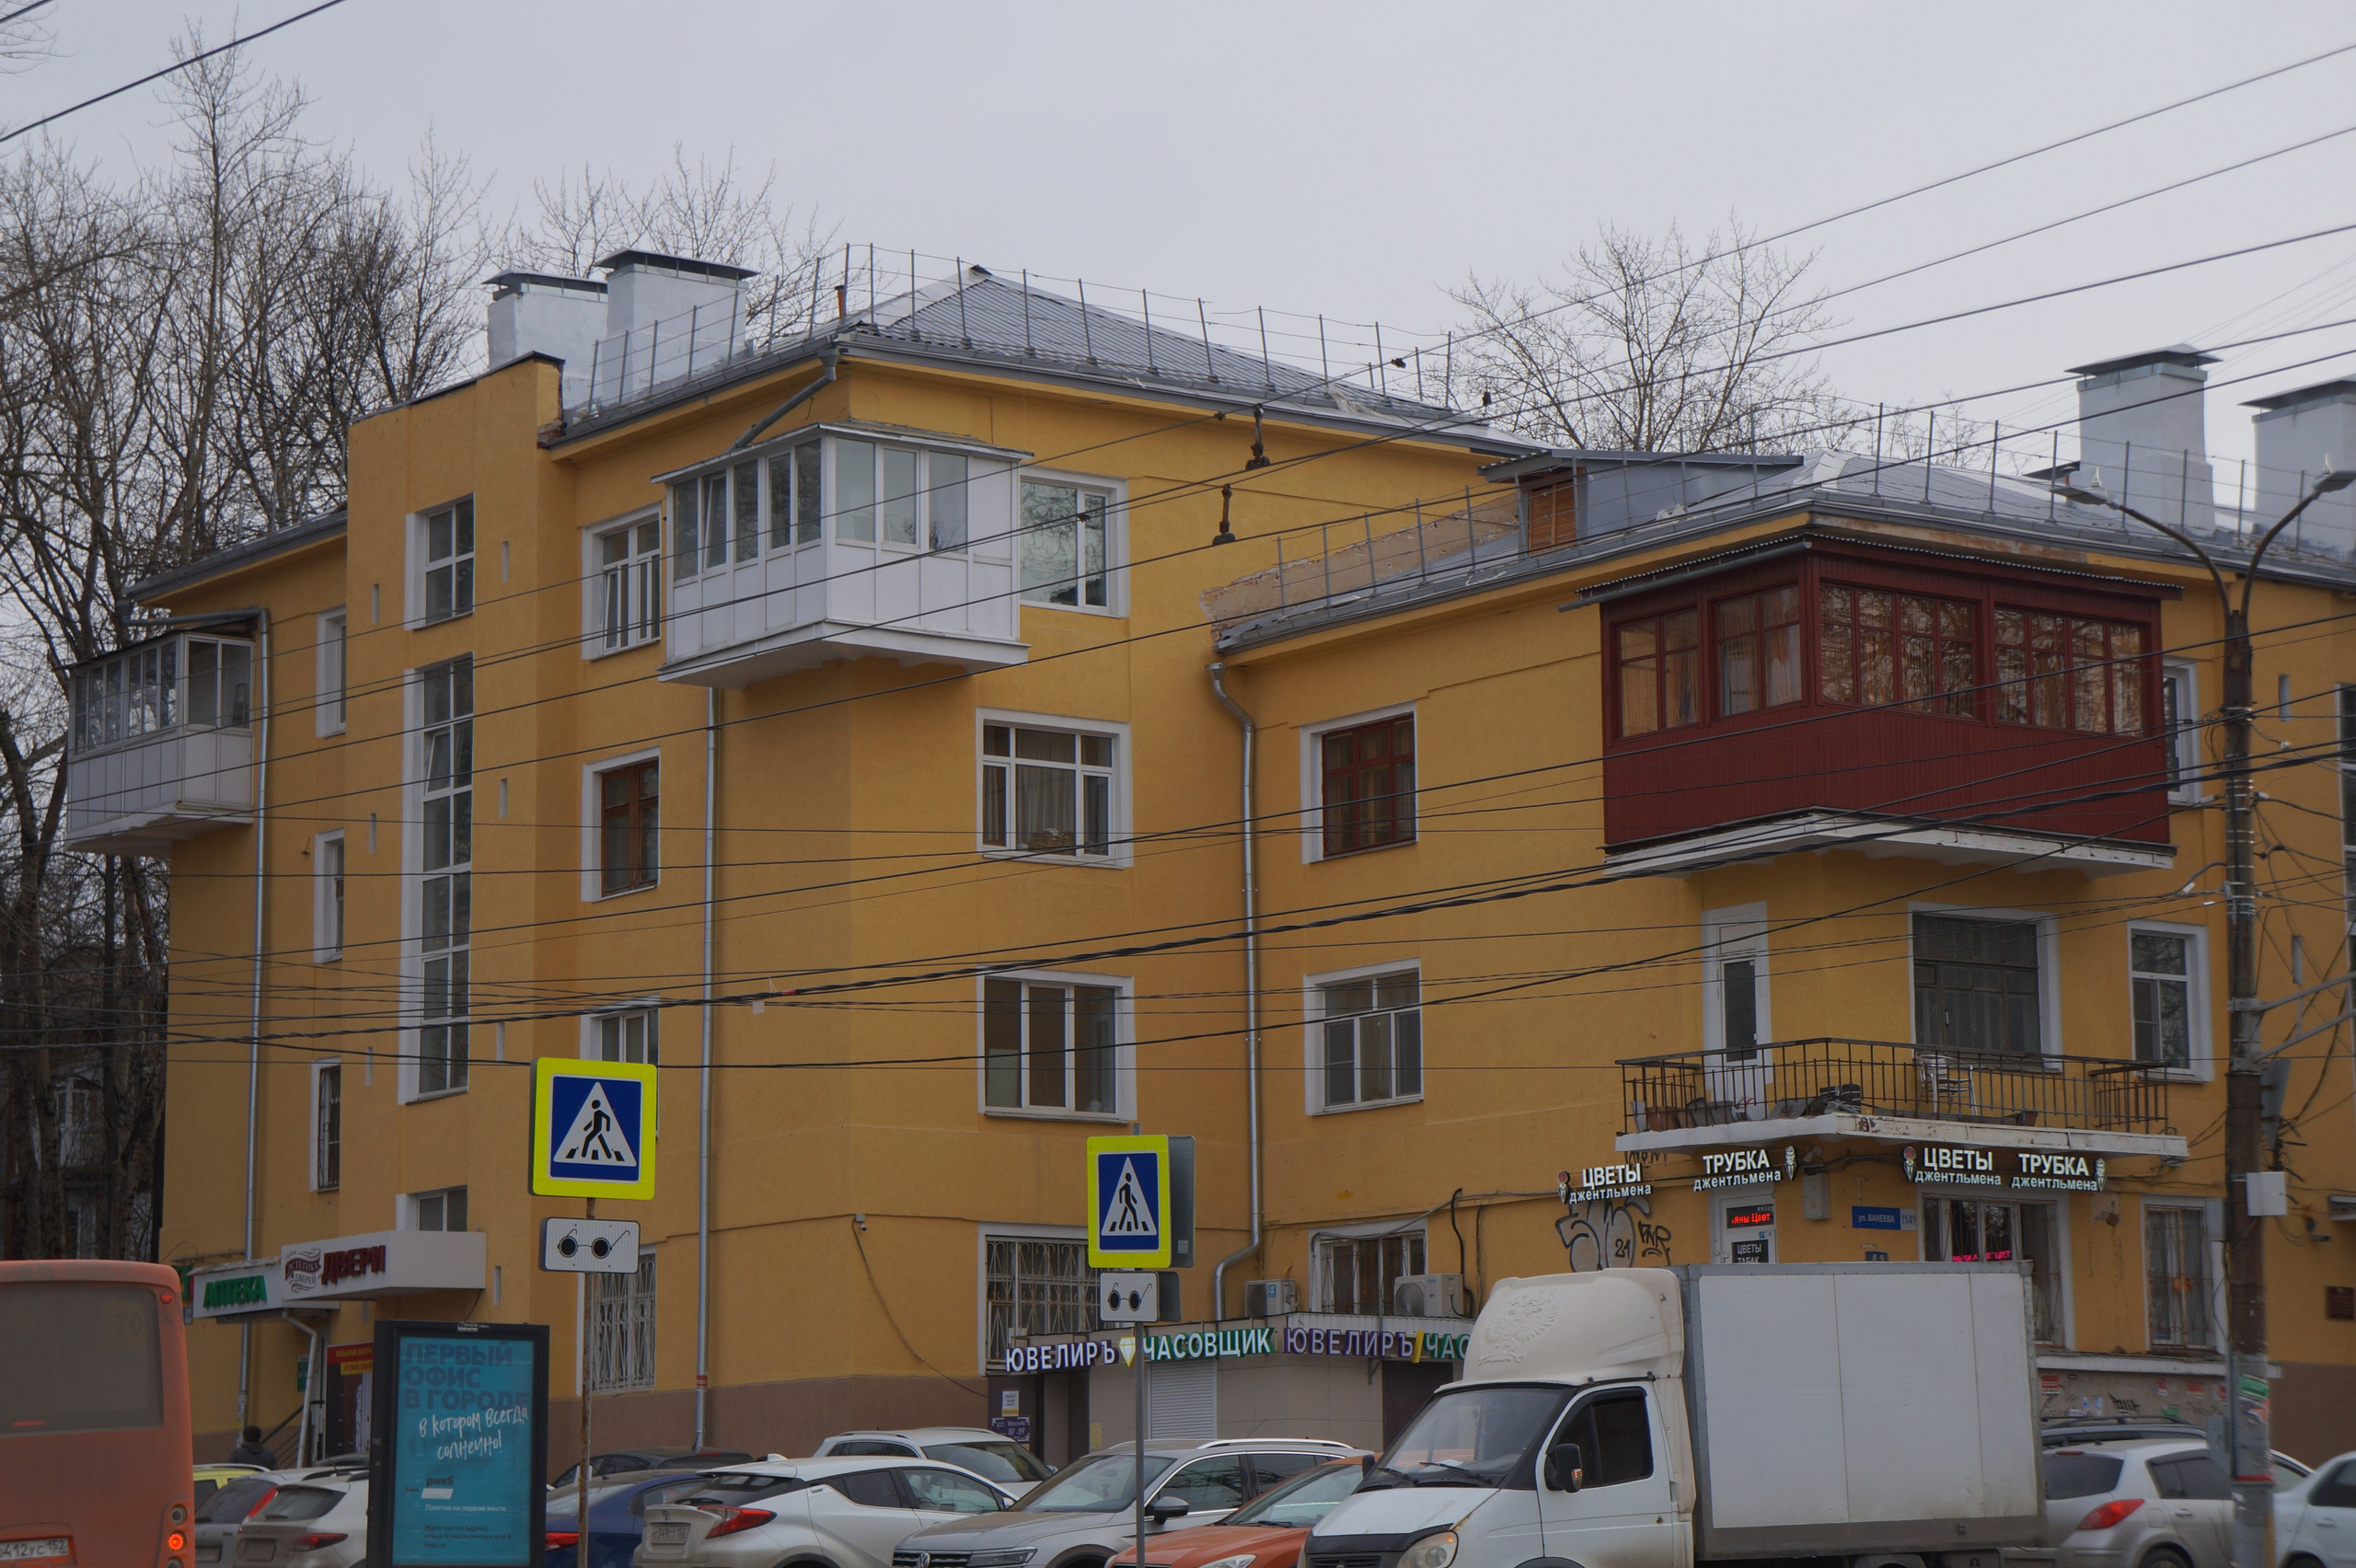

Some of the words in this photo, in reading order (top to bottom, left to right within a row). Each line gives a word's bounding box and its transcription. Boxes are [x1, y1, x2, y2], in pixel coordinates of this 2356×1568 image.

[1703, 1149, 1772, 1174] ТРУБКА
[1923, 1147, 1993, 1171] ЦВЕТЫ
[2018, 1153, 2090, 1177] ТРУБКА
[1581, 1162, 1642, 1190] ЦВЕТЫ
[1692, 1170, 1783, 1192] джентльмена
[1914, 1170, 2002, 1186] джентльмена
[2011, 1176, 2099, 1192] джентльмена
[1568, 1183, 1653, 1205] джентльмена
[1857, 1215, 1866, 1223] ул.
[1867, 1214, 1896, 1223] ВАНЕЕВА
[1737, 1243, 1762, 1255] ЦВЕТЫ
[322, 1245, 386, 1286] ДВЕРИ
[202, 1275, 267, 1309] АПТЕКА
[406, 1341, 513, 1366] ПЕРВЫЙ
[1005, 1339, 1117, 1372] ЮВЕЛИРЪ
[1142, 1328, 1274, 1361] ЧАСОВЩИК
[1284, 1328, 1414, 1357] ЮВЕЛИРЪ
[405, 1366, 480, 1389] ОФИС
[404, 1388, 422, 1410] В
[428, 1389, 530, 1412] ГОРОДЕ
[433, 1412, 481, 1438] котором
[437, 1429, 502, 1460] солнечно!
[426, 1475, 454, 1488] рнкб
[424, 1504, 452, 1512] Позитив
